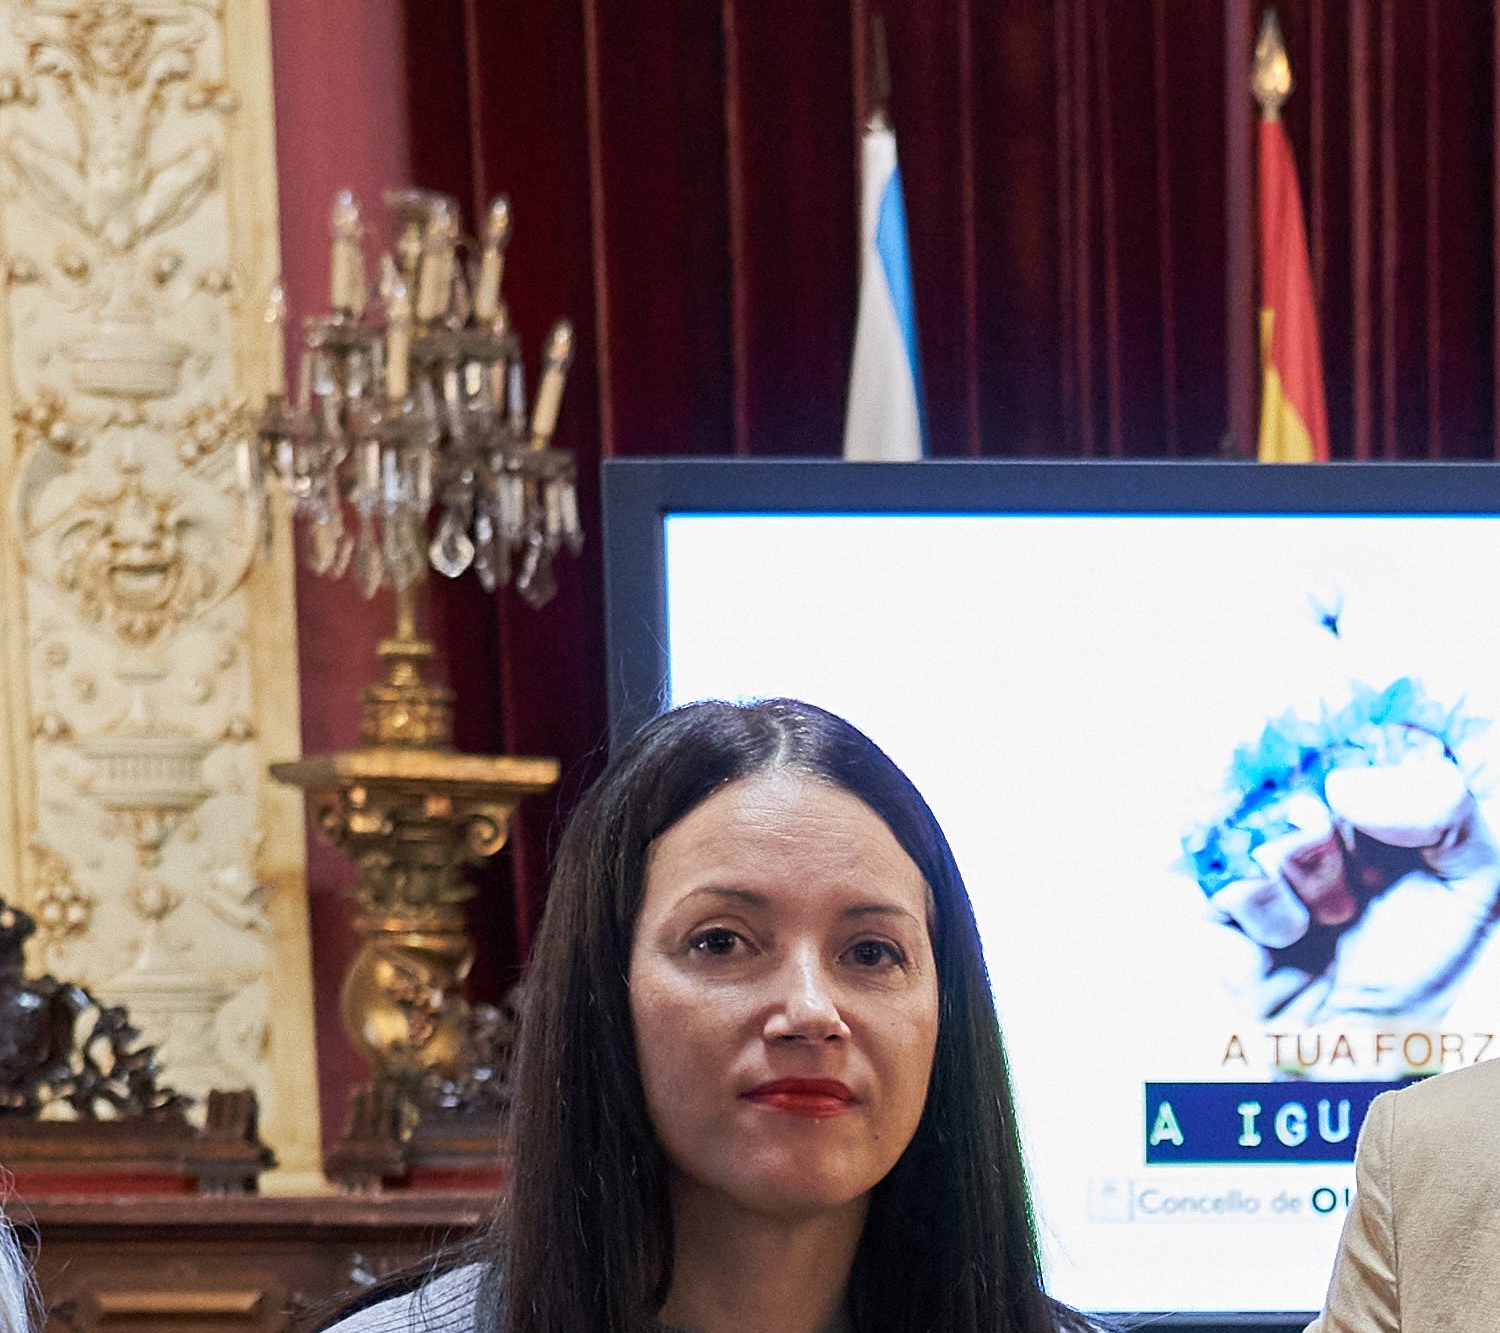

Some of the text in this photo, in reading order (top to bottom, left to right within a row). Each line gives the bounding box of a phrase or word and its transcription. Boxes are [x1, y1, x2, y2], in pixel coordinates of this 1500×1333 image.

[1222, 1034, 1248, 1066] A
[1149, 1100, 1184, 1146] A
[1138, 1188, 1261, 1215] Concello
[1270, 1188, 1301, 1215] de
